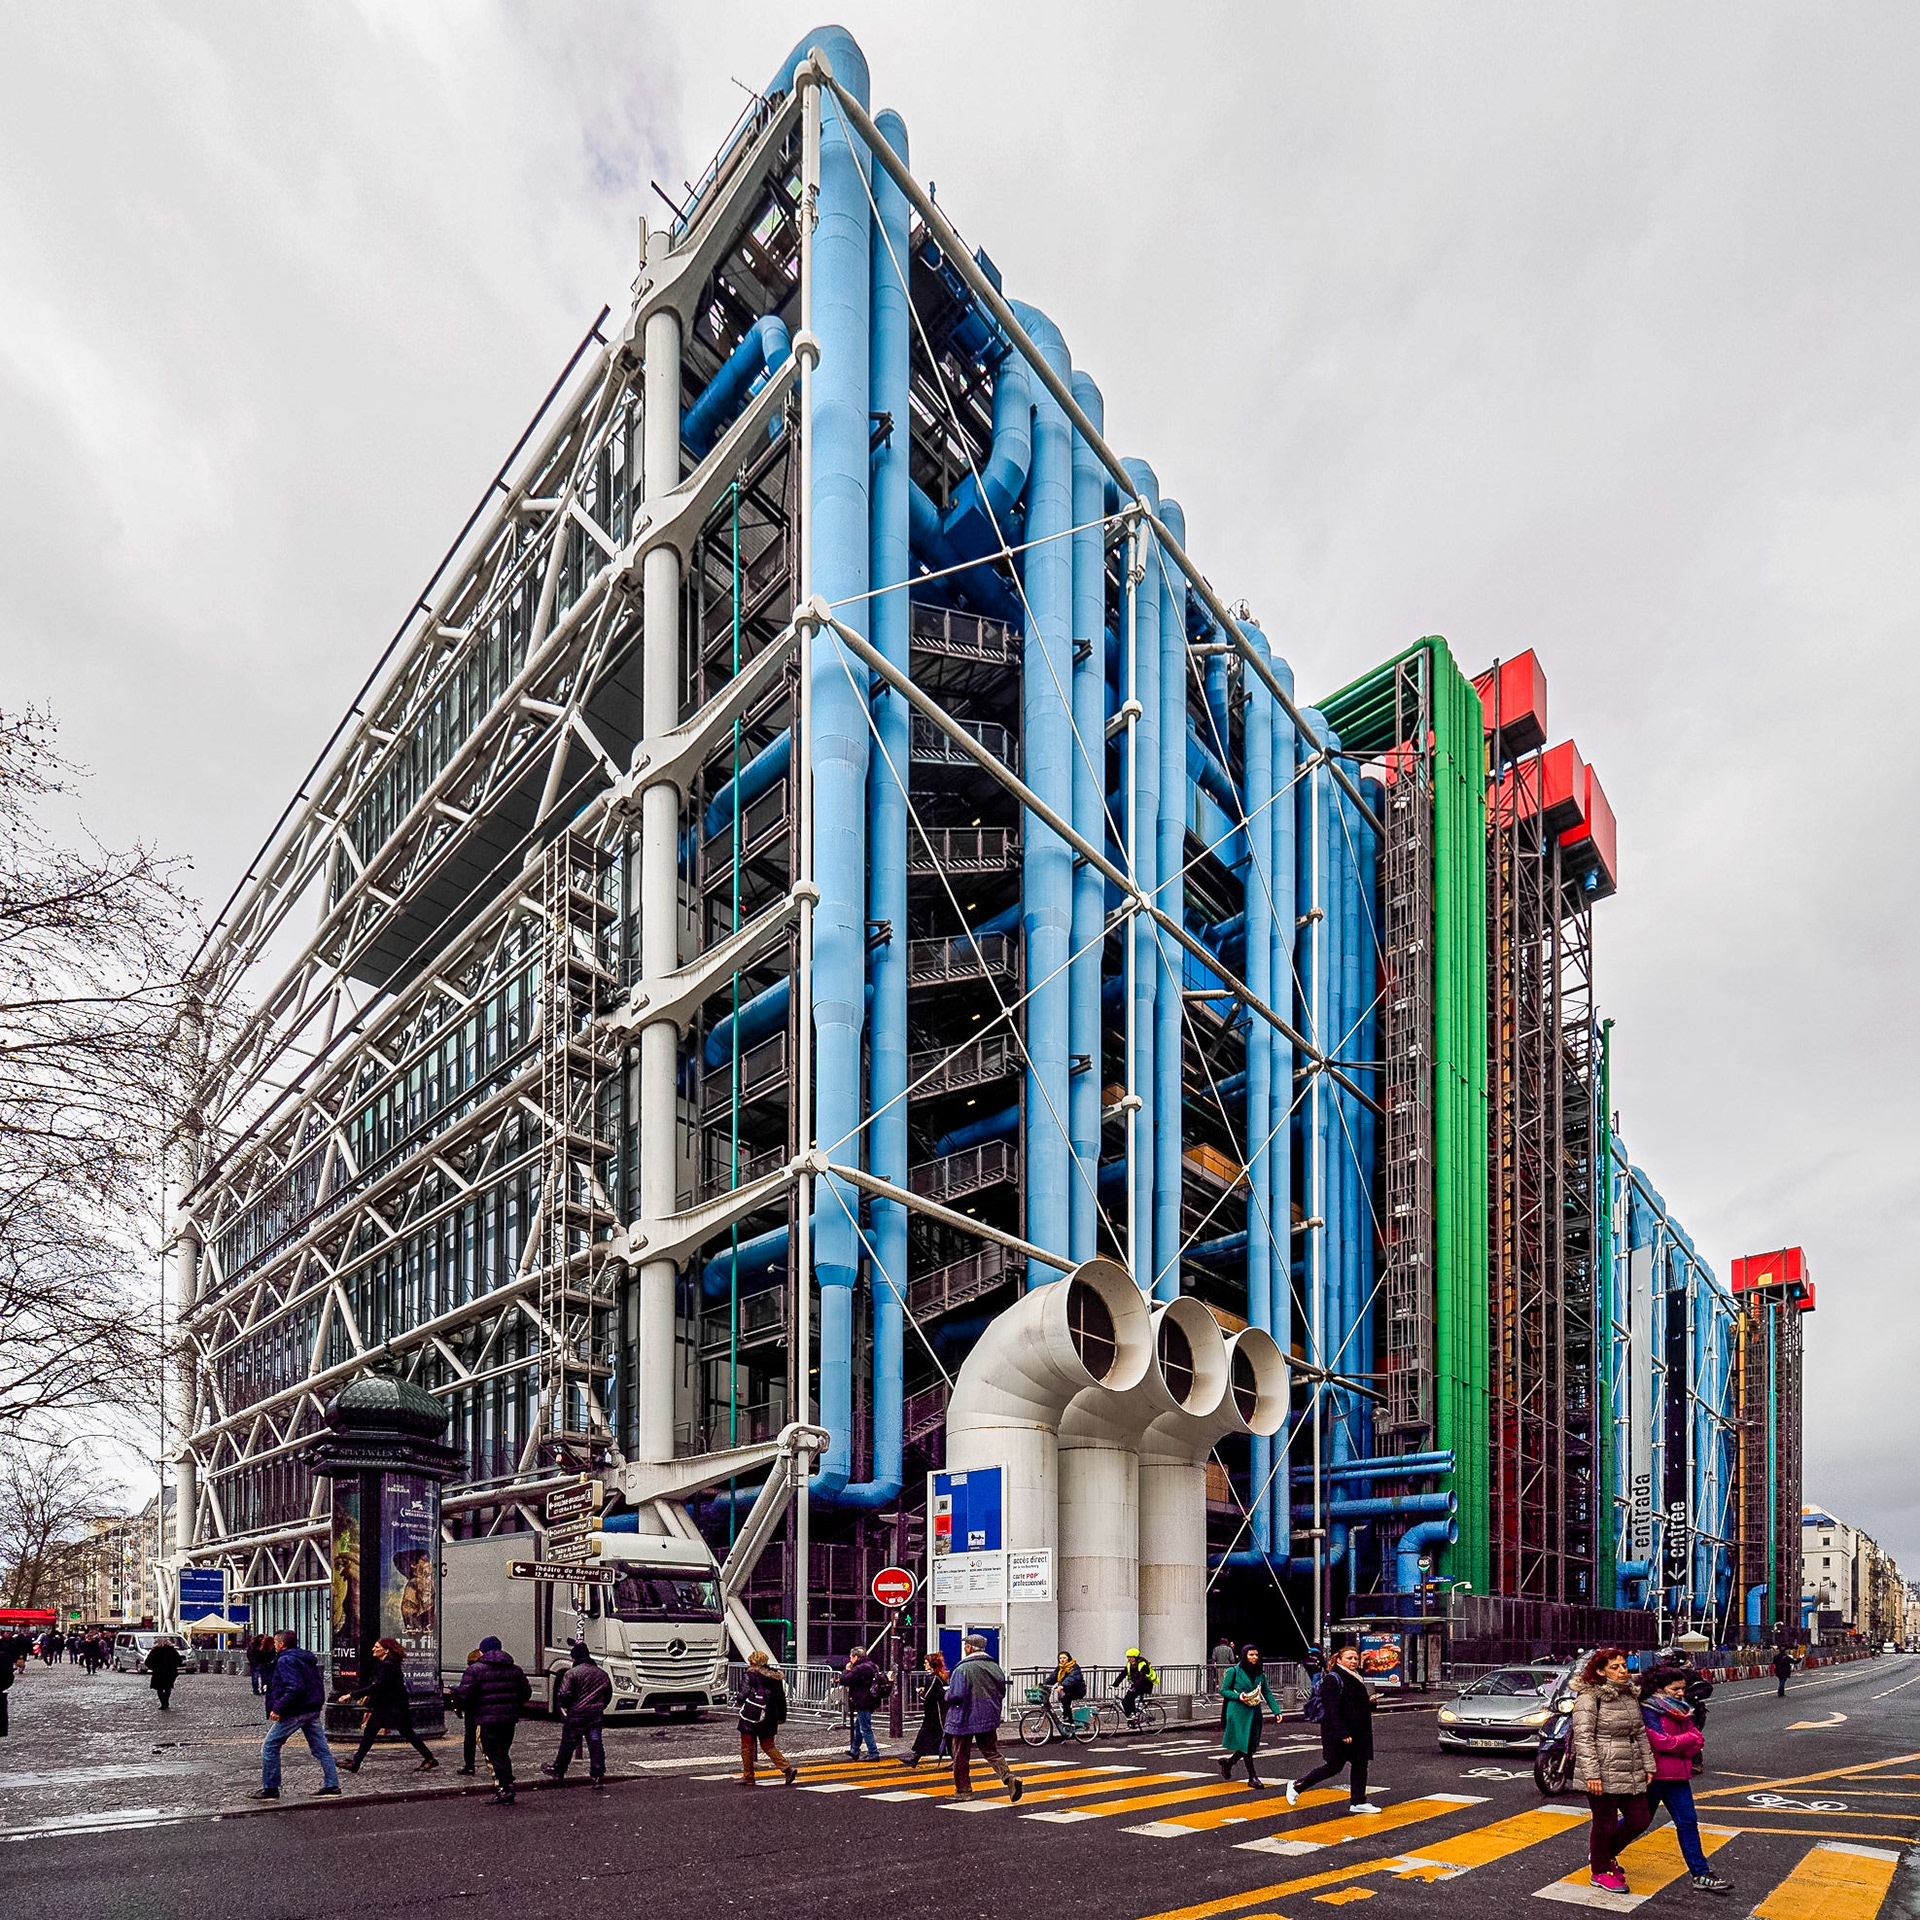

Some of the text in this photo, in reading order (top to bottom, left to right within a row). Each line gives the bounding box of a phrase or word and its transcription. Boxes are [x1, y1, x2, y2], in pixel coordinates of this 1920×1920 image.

[1632, 1473, 1650, 1548] entrada
[1013, 1555, 1047, 1564] accès direct
[535, 1565, 561, 1573] Théâtre
[575, 1568, 600, 1576] Renard
[1013, 1579, 1047, 1588] professionnels
